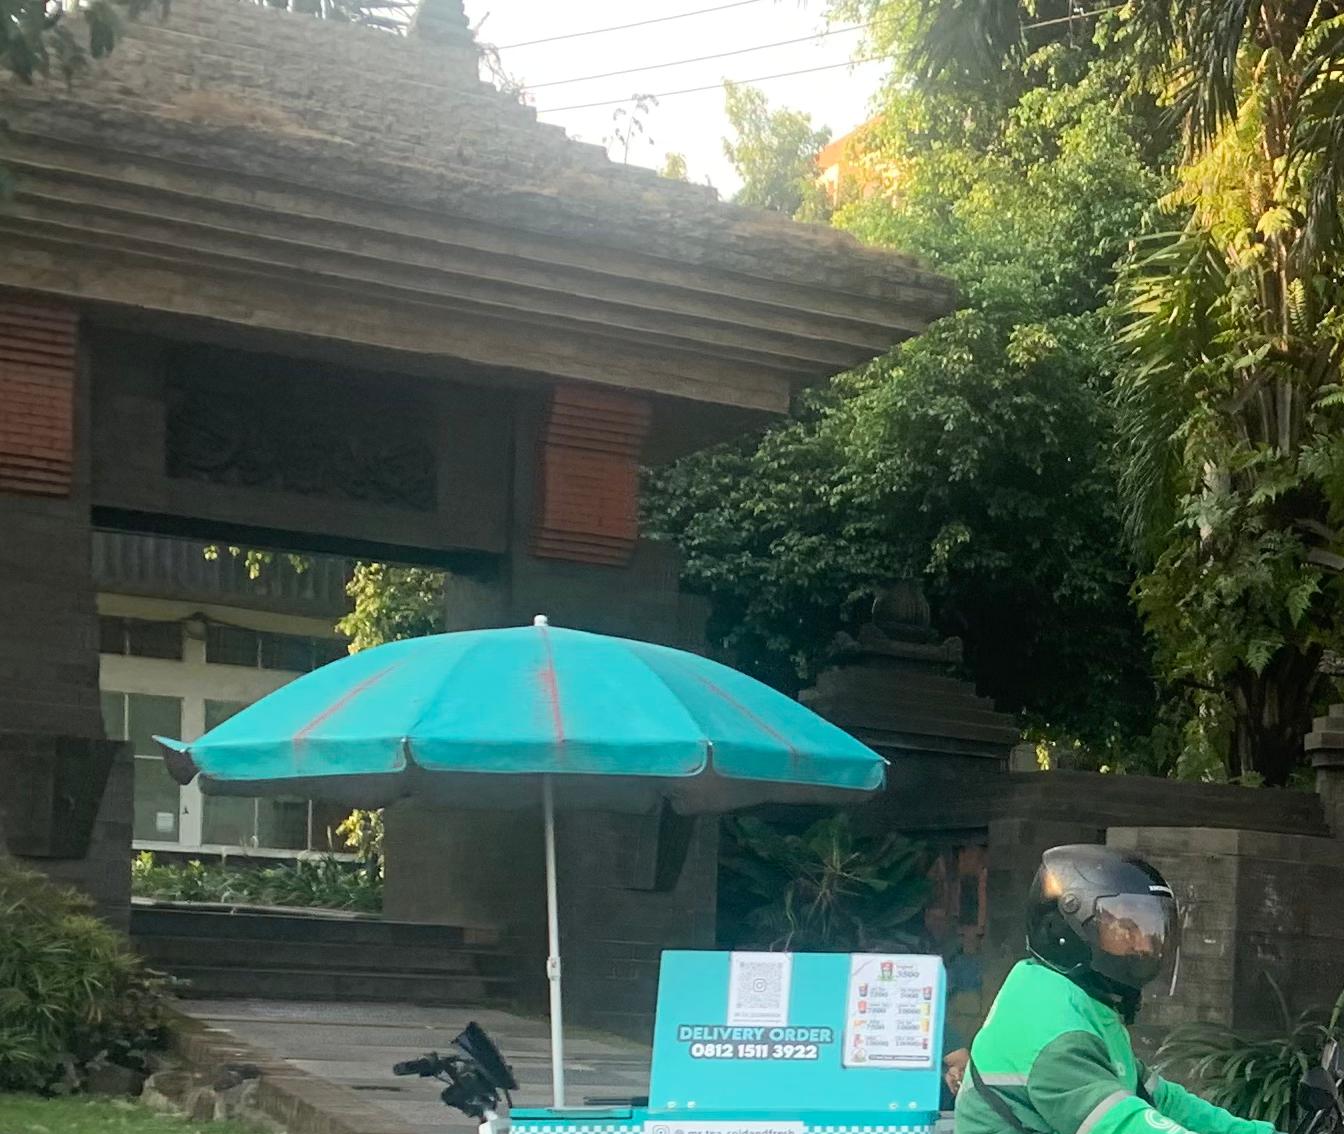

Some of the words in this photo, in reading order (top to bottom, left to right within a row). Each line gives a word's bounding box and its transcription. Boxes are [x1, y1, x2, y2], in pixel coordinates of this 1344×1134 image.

[679, 1026, 765, 1042] DELIVERY
[769, 1027, 832, 1042] ORDER
[691, 1043, 734, 1058] 0812
[737, 1044, 768, 1058] 1511
[772, 1044, 818, 1059] 3922
